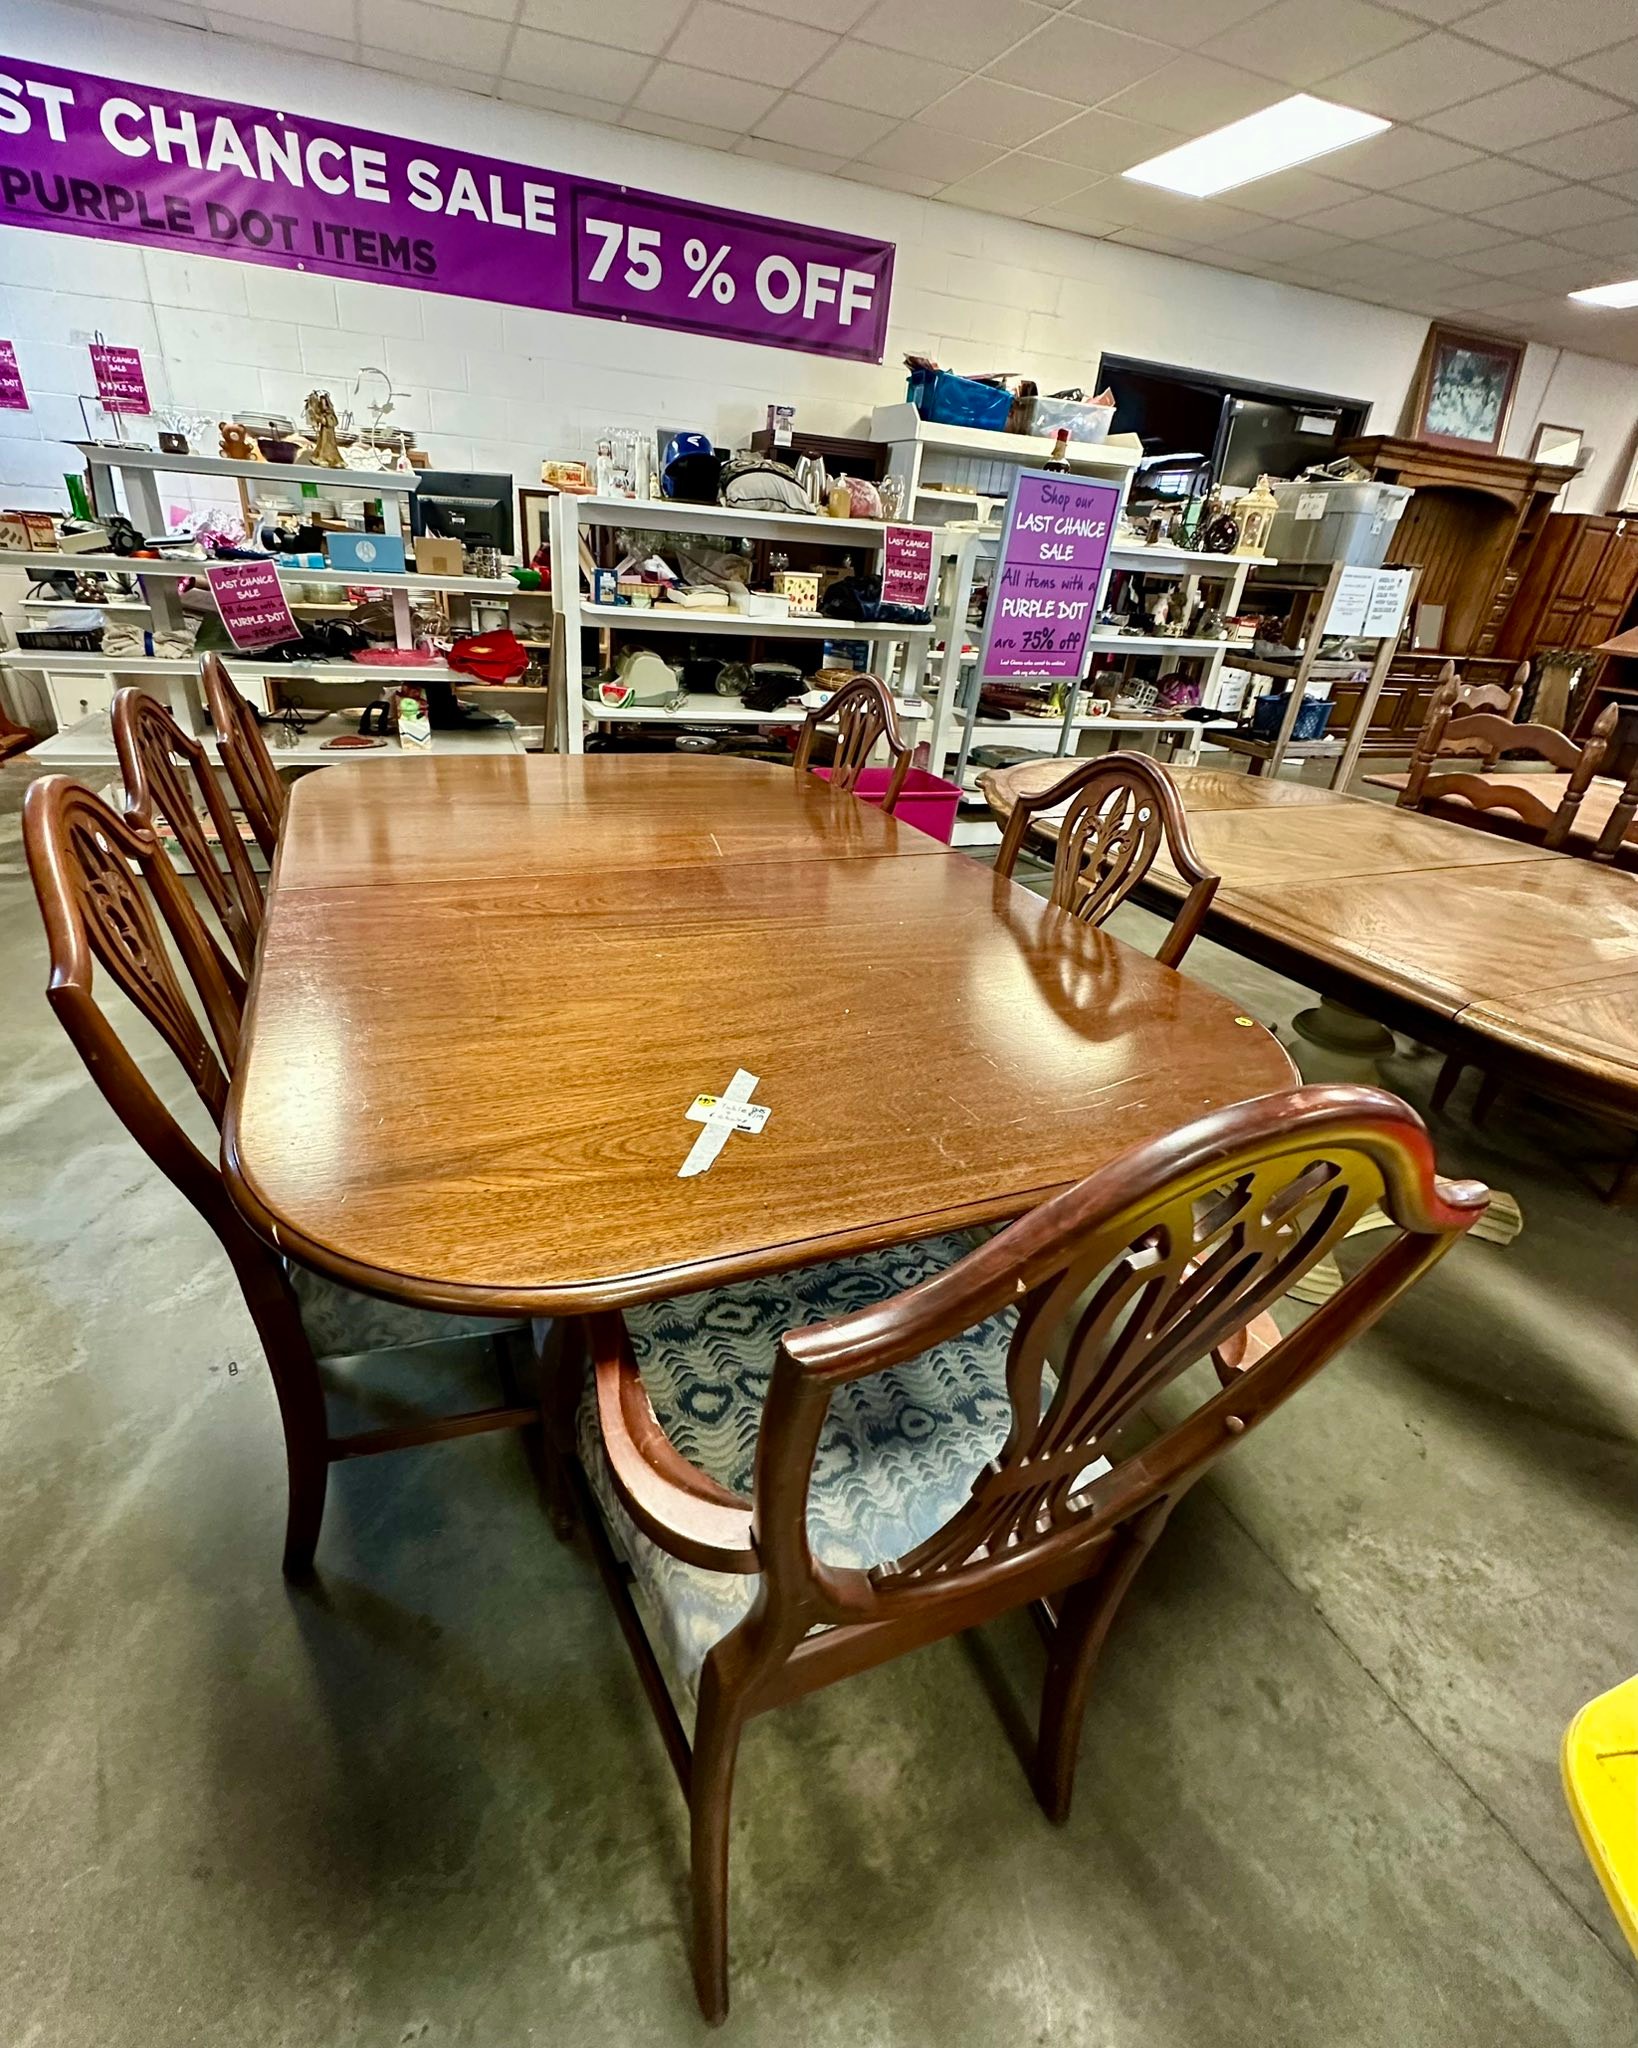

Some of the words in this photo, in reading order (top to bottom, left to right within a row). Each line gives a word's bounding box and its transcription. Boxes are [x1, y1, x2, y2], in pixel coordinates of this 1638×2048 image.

[100, 97, 391, 204] CHANCE
[406, 158, 557, 236] SALE
[1, 166, 195, 235] PURPLE
[205, 202, 299, 251] DOT
[313, 220, 437, 275] ITEMS
[585, 217, 662, 292] 75
[683, 238, 736, 305] %
[755, 254, 877, 326] OFF
[128, 384, 144, 393] DOT
[1041, 484, 1071, 512] Shop
[1075, 496, 1094, 509] our
[1016, 512, 1054, 533] LAST
[1054, 516, 1106, 538] CHANCE
[888, 537, 905, 546] LAST
[905, 540, 930, 549] CHANCE
[1040, 543, 1074, 561] SALE
[900, 549, 917, 557] SALE
[215, 580, 237, 590] LAST
[240, 575, 275, 587] CHANCE
[888, 568, 912, 579] PURPLE
[913, 571, 928, 581] DOT
[1001, 567, 1020, 587] All
[1025, 570, 1056, 589] items
[1061, 574, 1084, 591] with
[1088, 582, 1097, 591] a
[236, 588, 261, 600] SALE
[1001, 598, 1055, 618] PURPLE
[1057, 600, 1088, 619] DOT
[229, 614, 266, 629] PURPLE
[265, 611, 286, 624] DOT
[994, 638, 1017, 649] are
[1022, 626, 1056, 651] 75%
[1060, 632, 1081, 651] off
